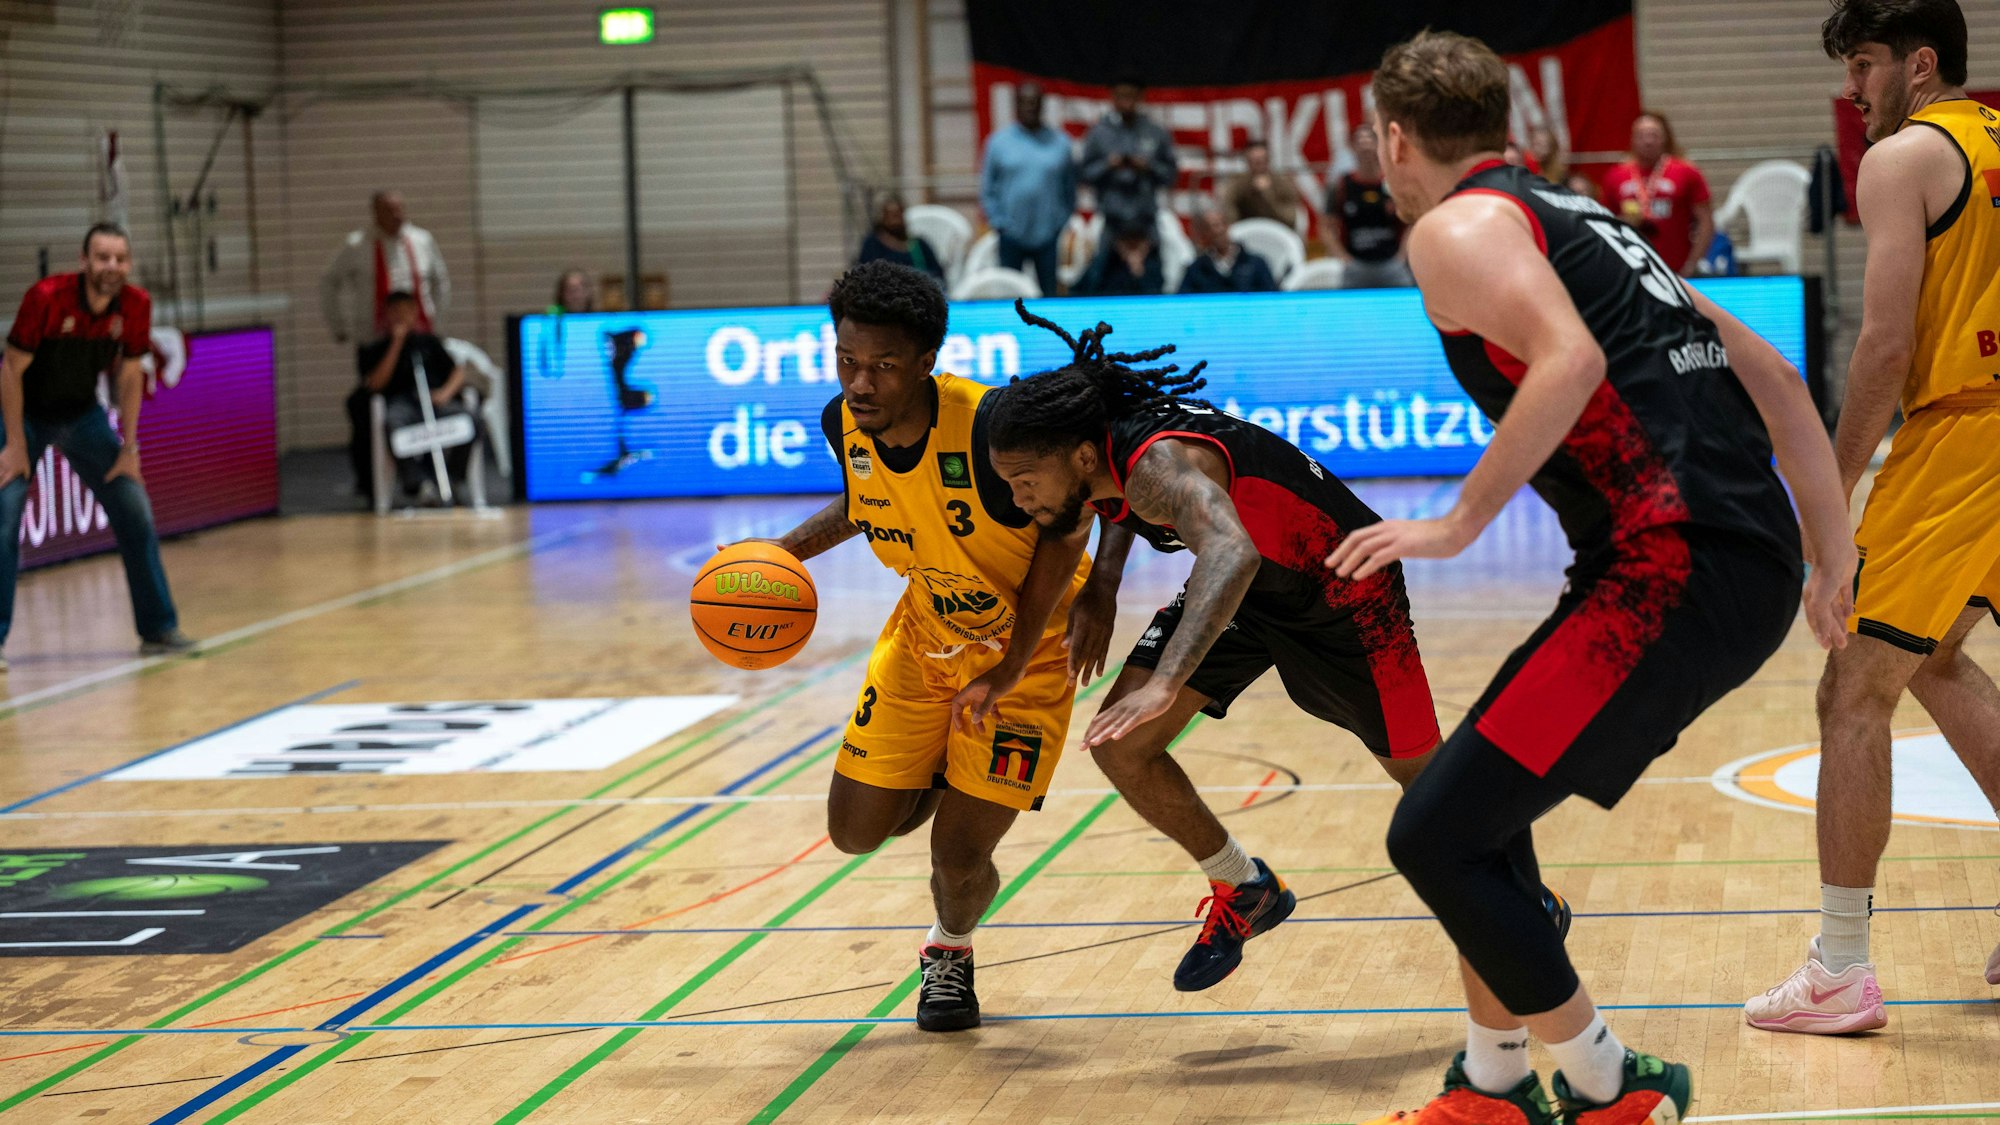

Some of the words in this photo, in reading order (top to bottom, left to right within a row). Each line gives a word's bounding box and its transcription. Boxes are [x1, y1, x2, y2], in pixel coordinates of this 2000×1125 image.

[708, 404, 809, 469] die
[859, 494, 891, 509] Kempa
[946, 499, 975, 537] 3
[715, 571, 801, 602] Wilson
[727, 622, 779, 640] EVO
[855, 685, 877, 727] 3
[986, 775, 1031, 792] DEUTSCHLAND
